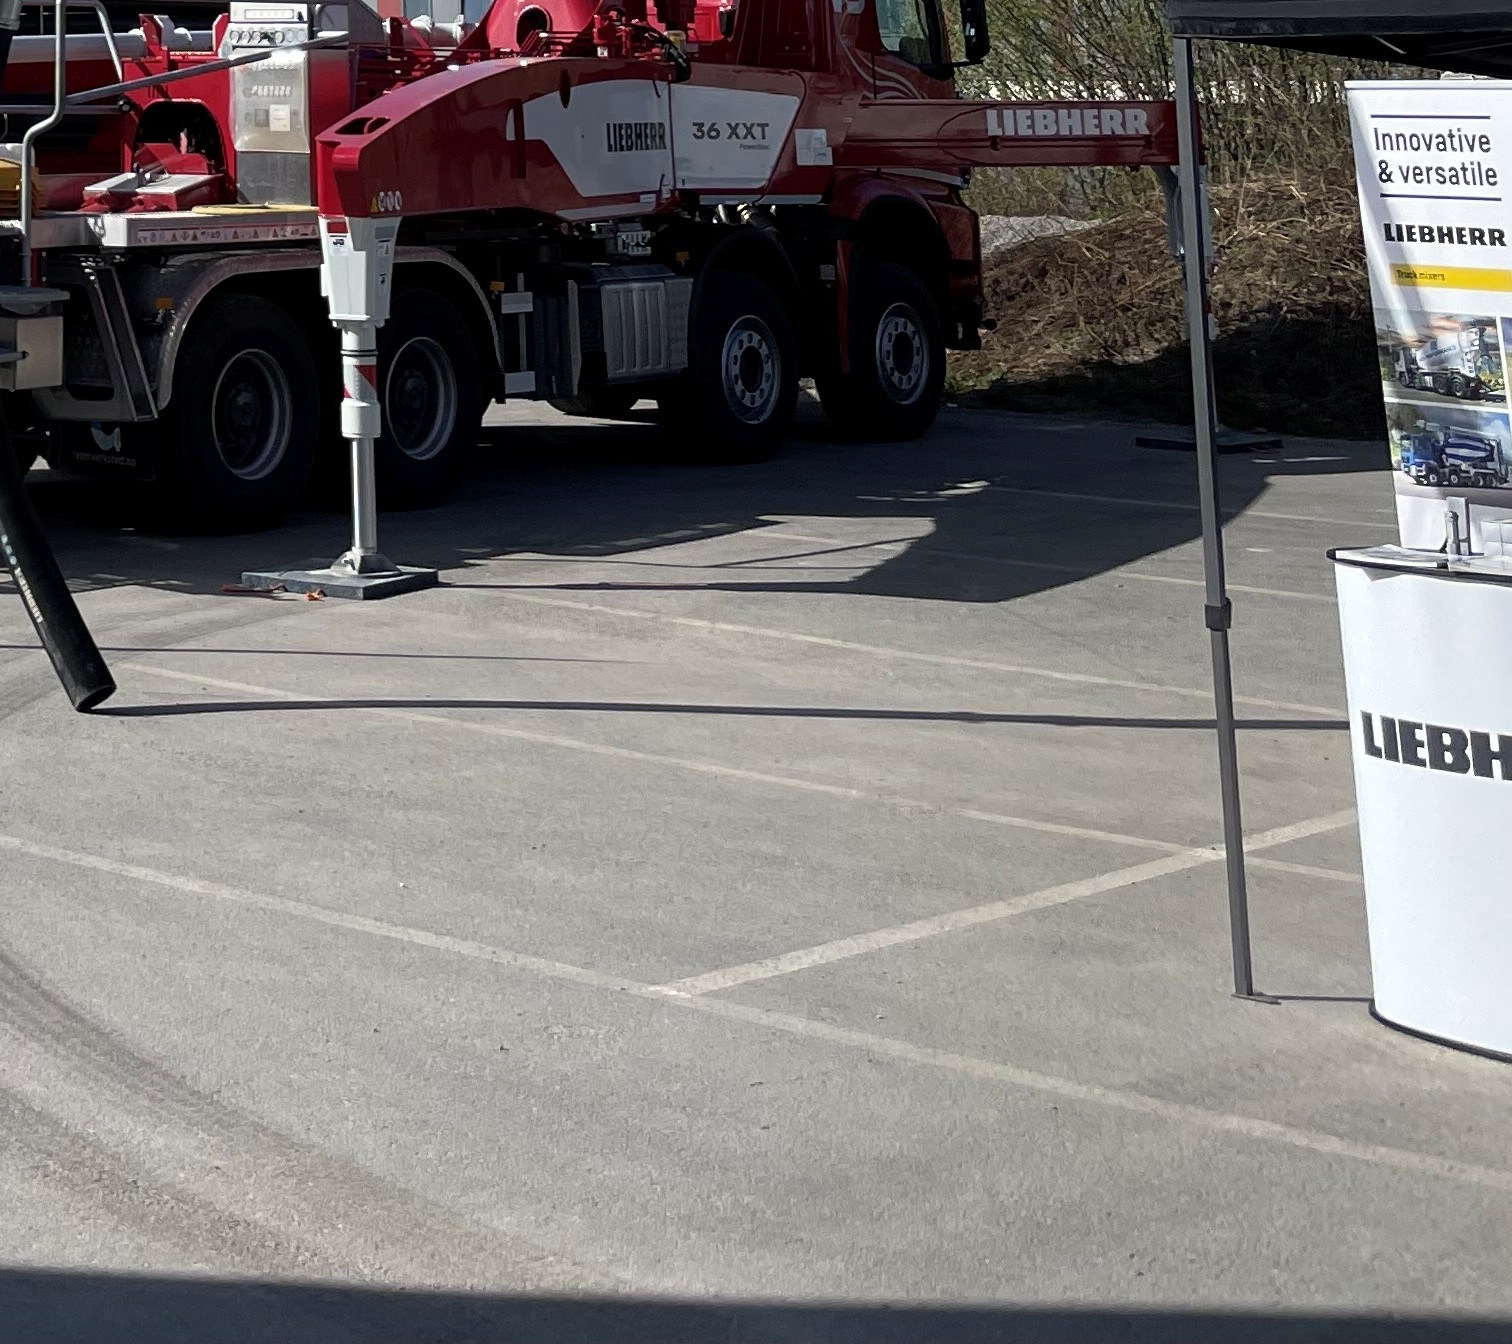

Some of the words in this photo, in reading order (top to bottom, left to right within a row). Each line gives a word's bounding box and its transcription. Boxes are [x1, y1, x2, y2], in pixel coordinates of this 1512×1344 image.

[606, 112, 667, 152] LIEBHERR
[692, 122, 720, 140] 36
[726, 122, 770, 140] XXT
[987, 108, 1150, 136] LIEBHERR
[1373, 127, 1491, 153] Innovative
[1378, 159, 1394, 184] &
[1399, 161, 1498, 187] versatile
[1383, 223, 1506, 247] LIEBHERR
